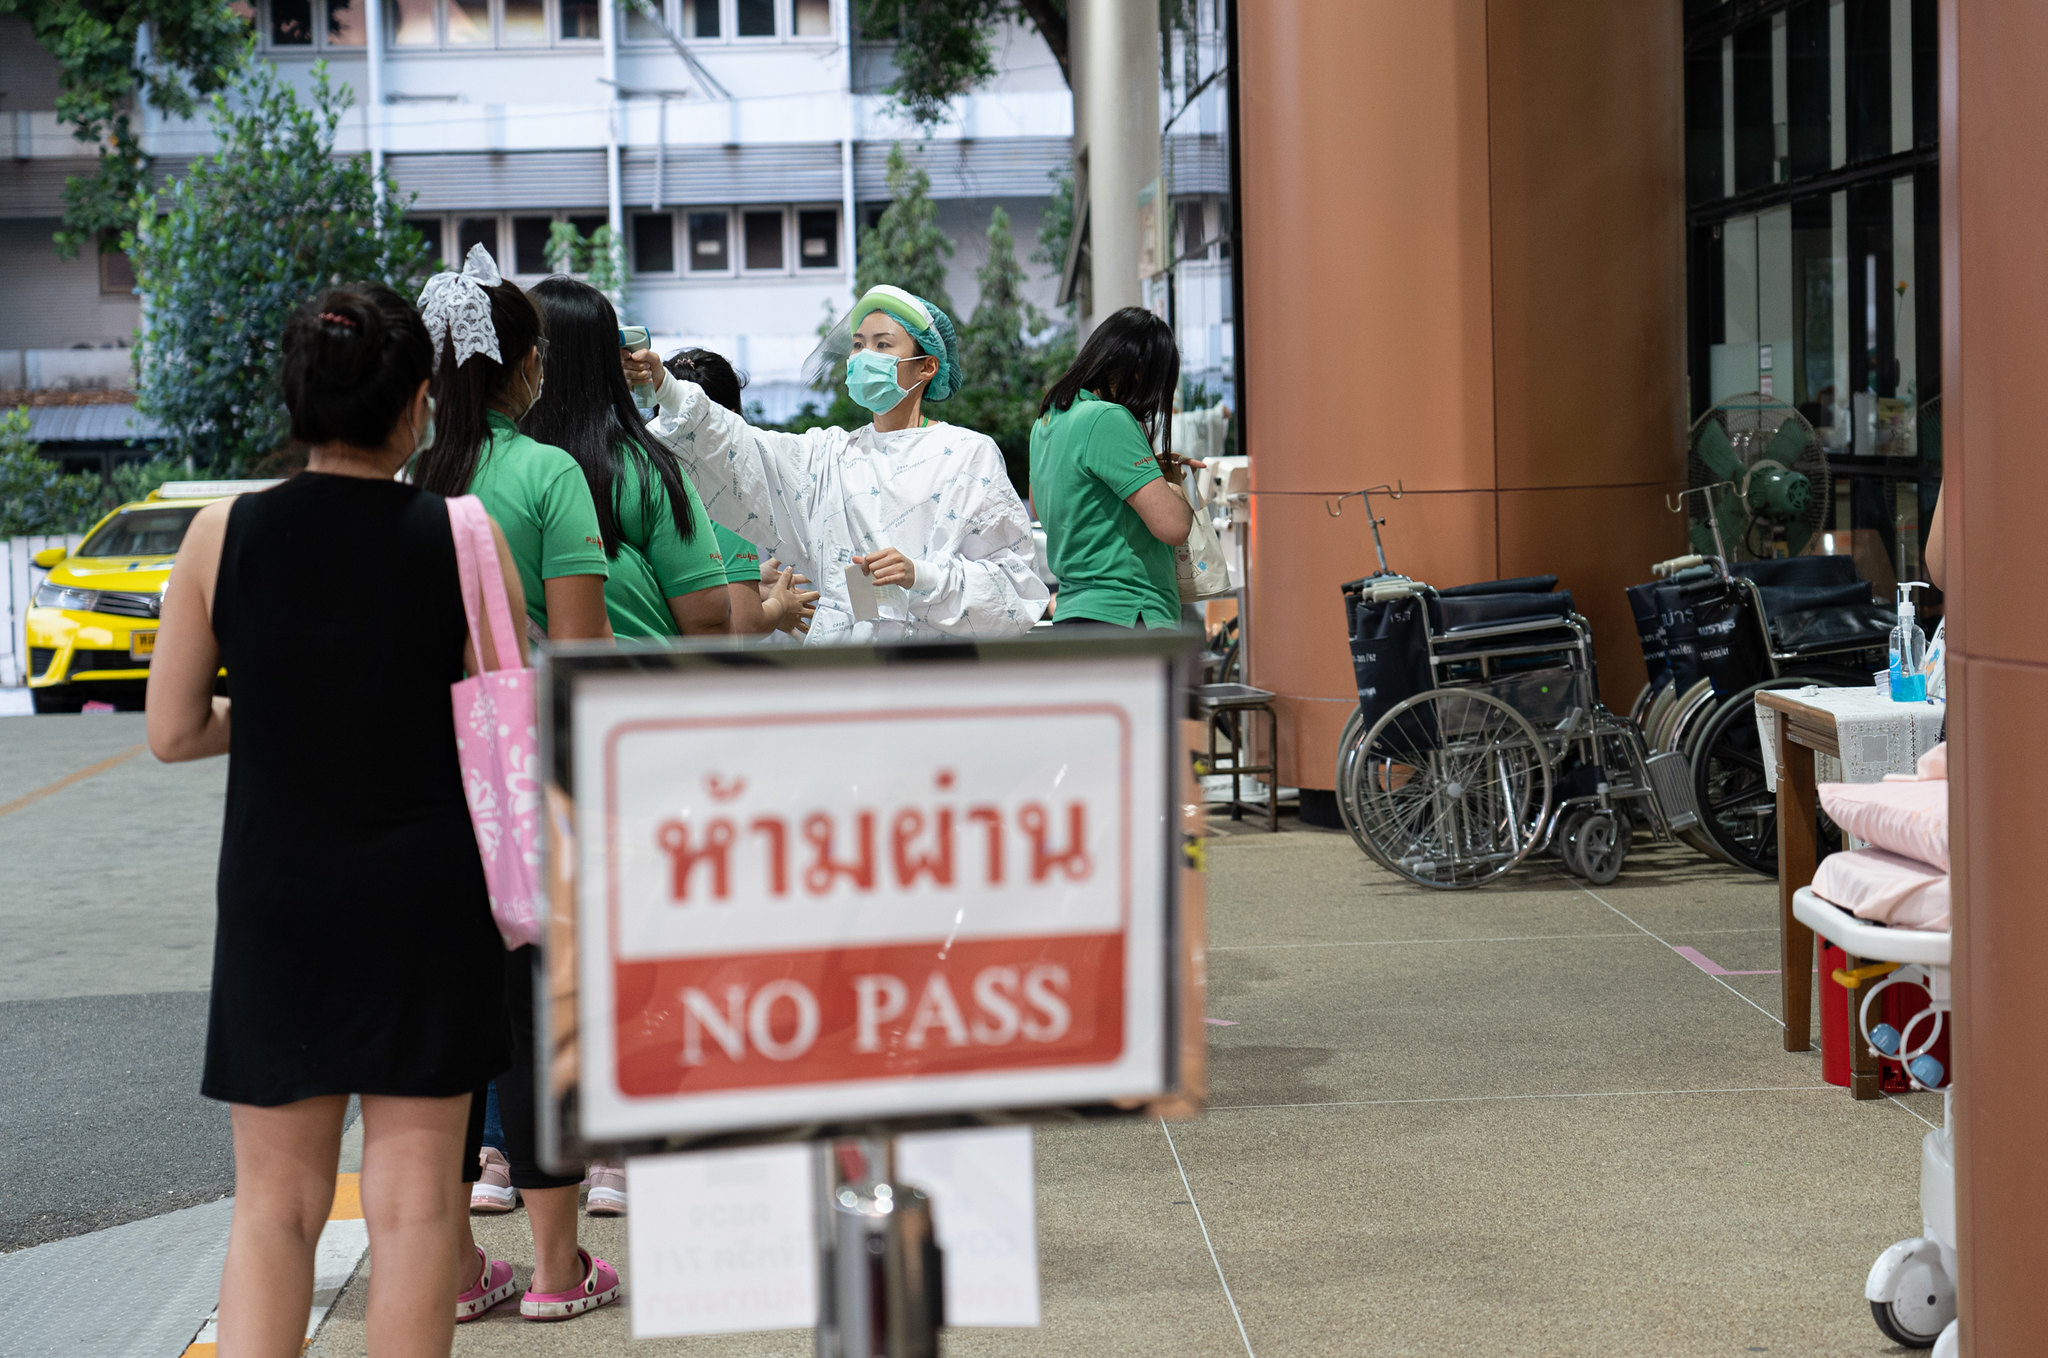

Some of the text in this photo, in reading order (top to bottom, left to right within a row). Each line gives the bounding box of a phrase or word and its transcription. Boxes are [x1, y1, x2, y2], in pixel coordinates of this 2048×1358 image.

[656, 766, 1095, 905] ห้ามผ่าน
[678, 964, 1073, 1068] NO PASS
